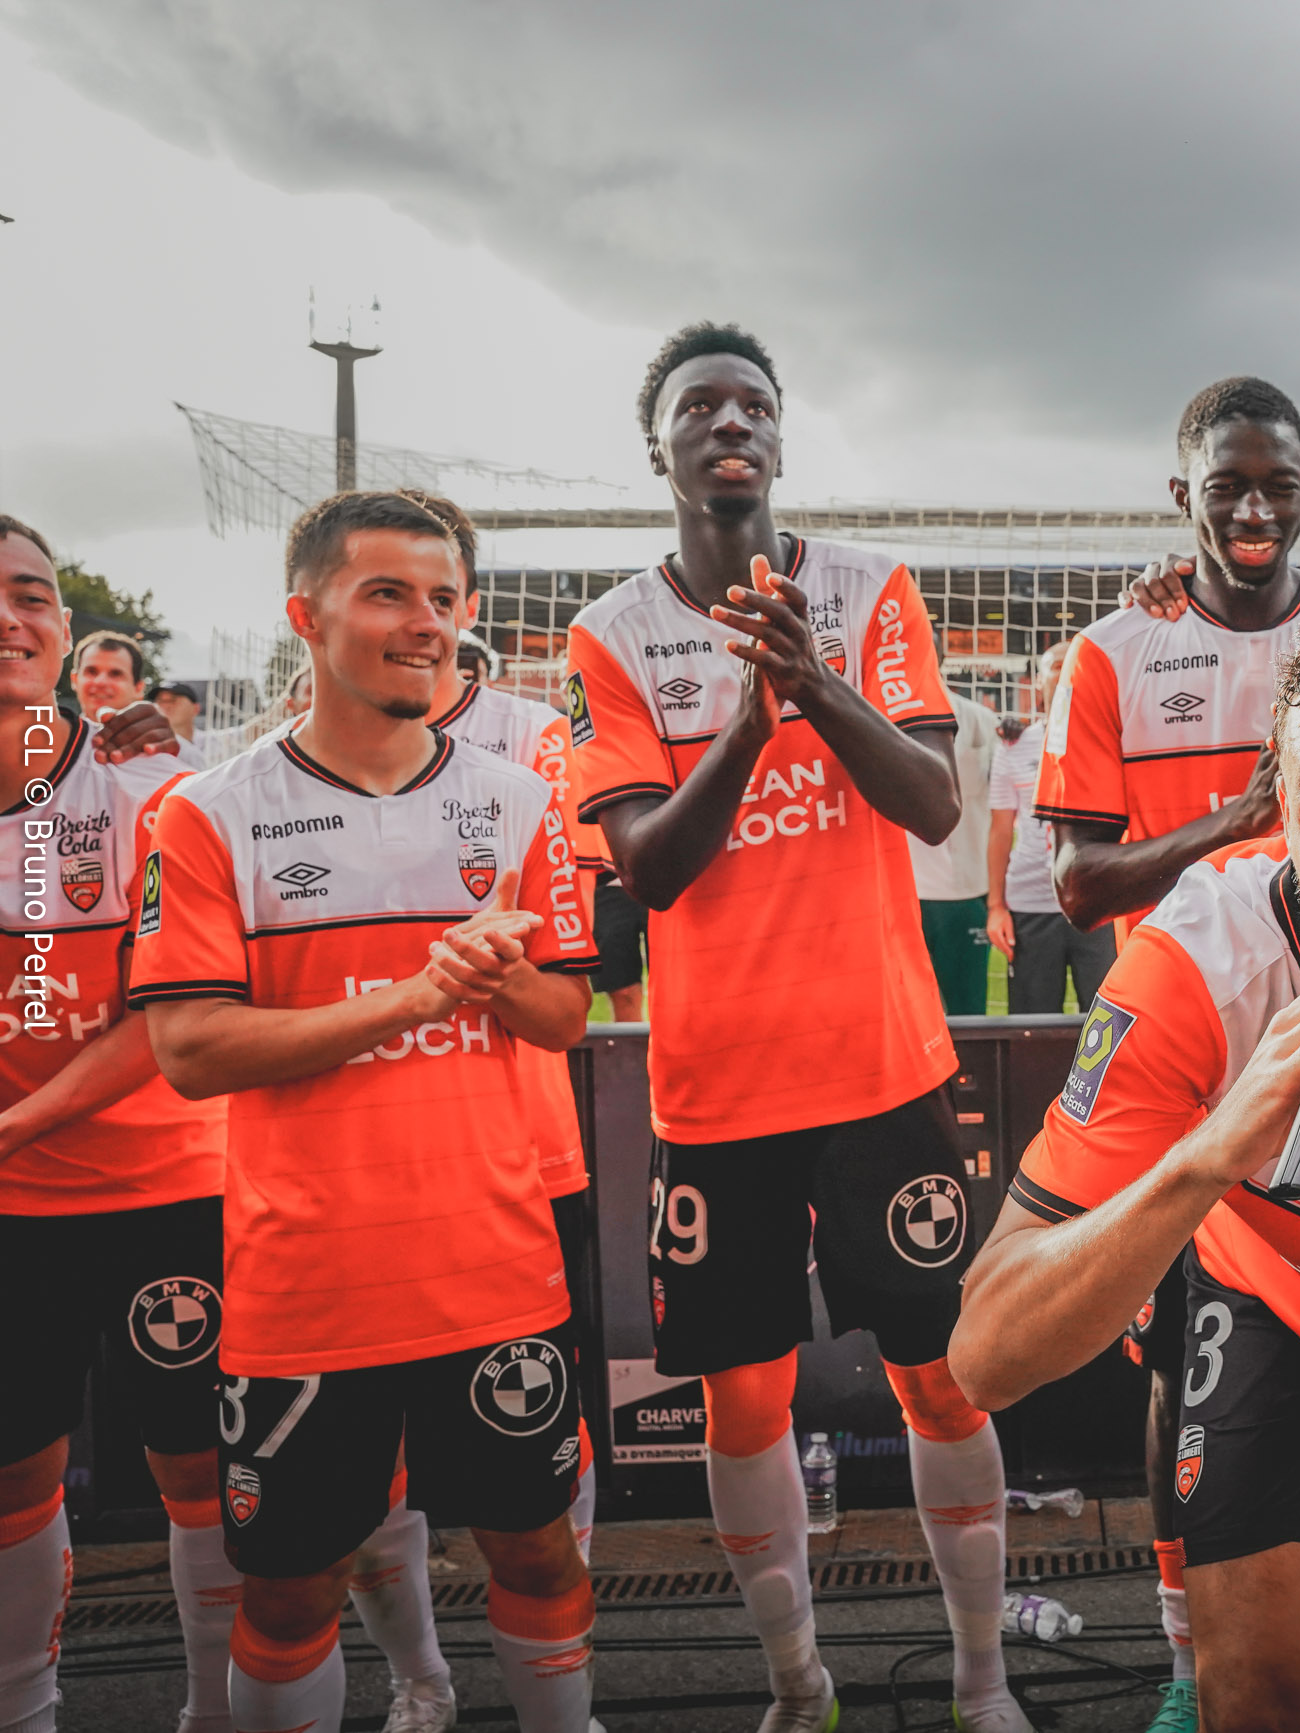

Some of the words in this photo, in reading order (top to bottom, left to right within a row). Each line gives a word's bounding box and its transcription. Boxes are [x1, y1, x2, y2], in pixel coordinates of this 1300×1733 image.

[877, 599, 926, 717] actual
[1145, 653, 1219, 674] ACADOMIA
[661, 698, 700, 711] umbro
[1164, 713, 1203, 724] umbro
[538, 733, 572, 803] act
[442, 797, 502, 821] Breizh
[50, 809, 111, 837] Breizh
[252, 815, 344, 840] ACADOMIA
[458, 819, 497, 840] Cola
[57, 834, 103, 857] Cola
[543, 807, 588, 951] actual
[280, 886, 328, 901] umbro
[0, 972, 80, 1004] AN
[1086, 1086, 1092, 1098] 1
[1067, 1096, 1087, 1116] Eats
[898, 1180, 958, 1209] BMW
[139, 1281, 211, 1309] BMW
[483, 1343, 556, 1379] BMW
[1184, 1301, 1233, 1408] 3
[219, 1373, 322, 1458] 37
[636, 1408, 706, 1424] CHARVE
[1182, 1445, 1201, 1459] LORIENT
